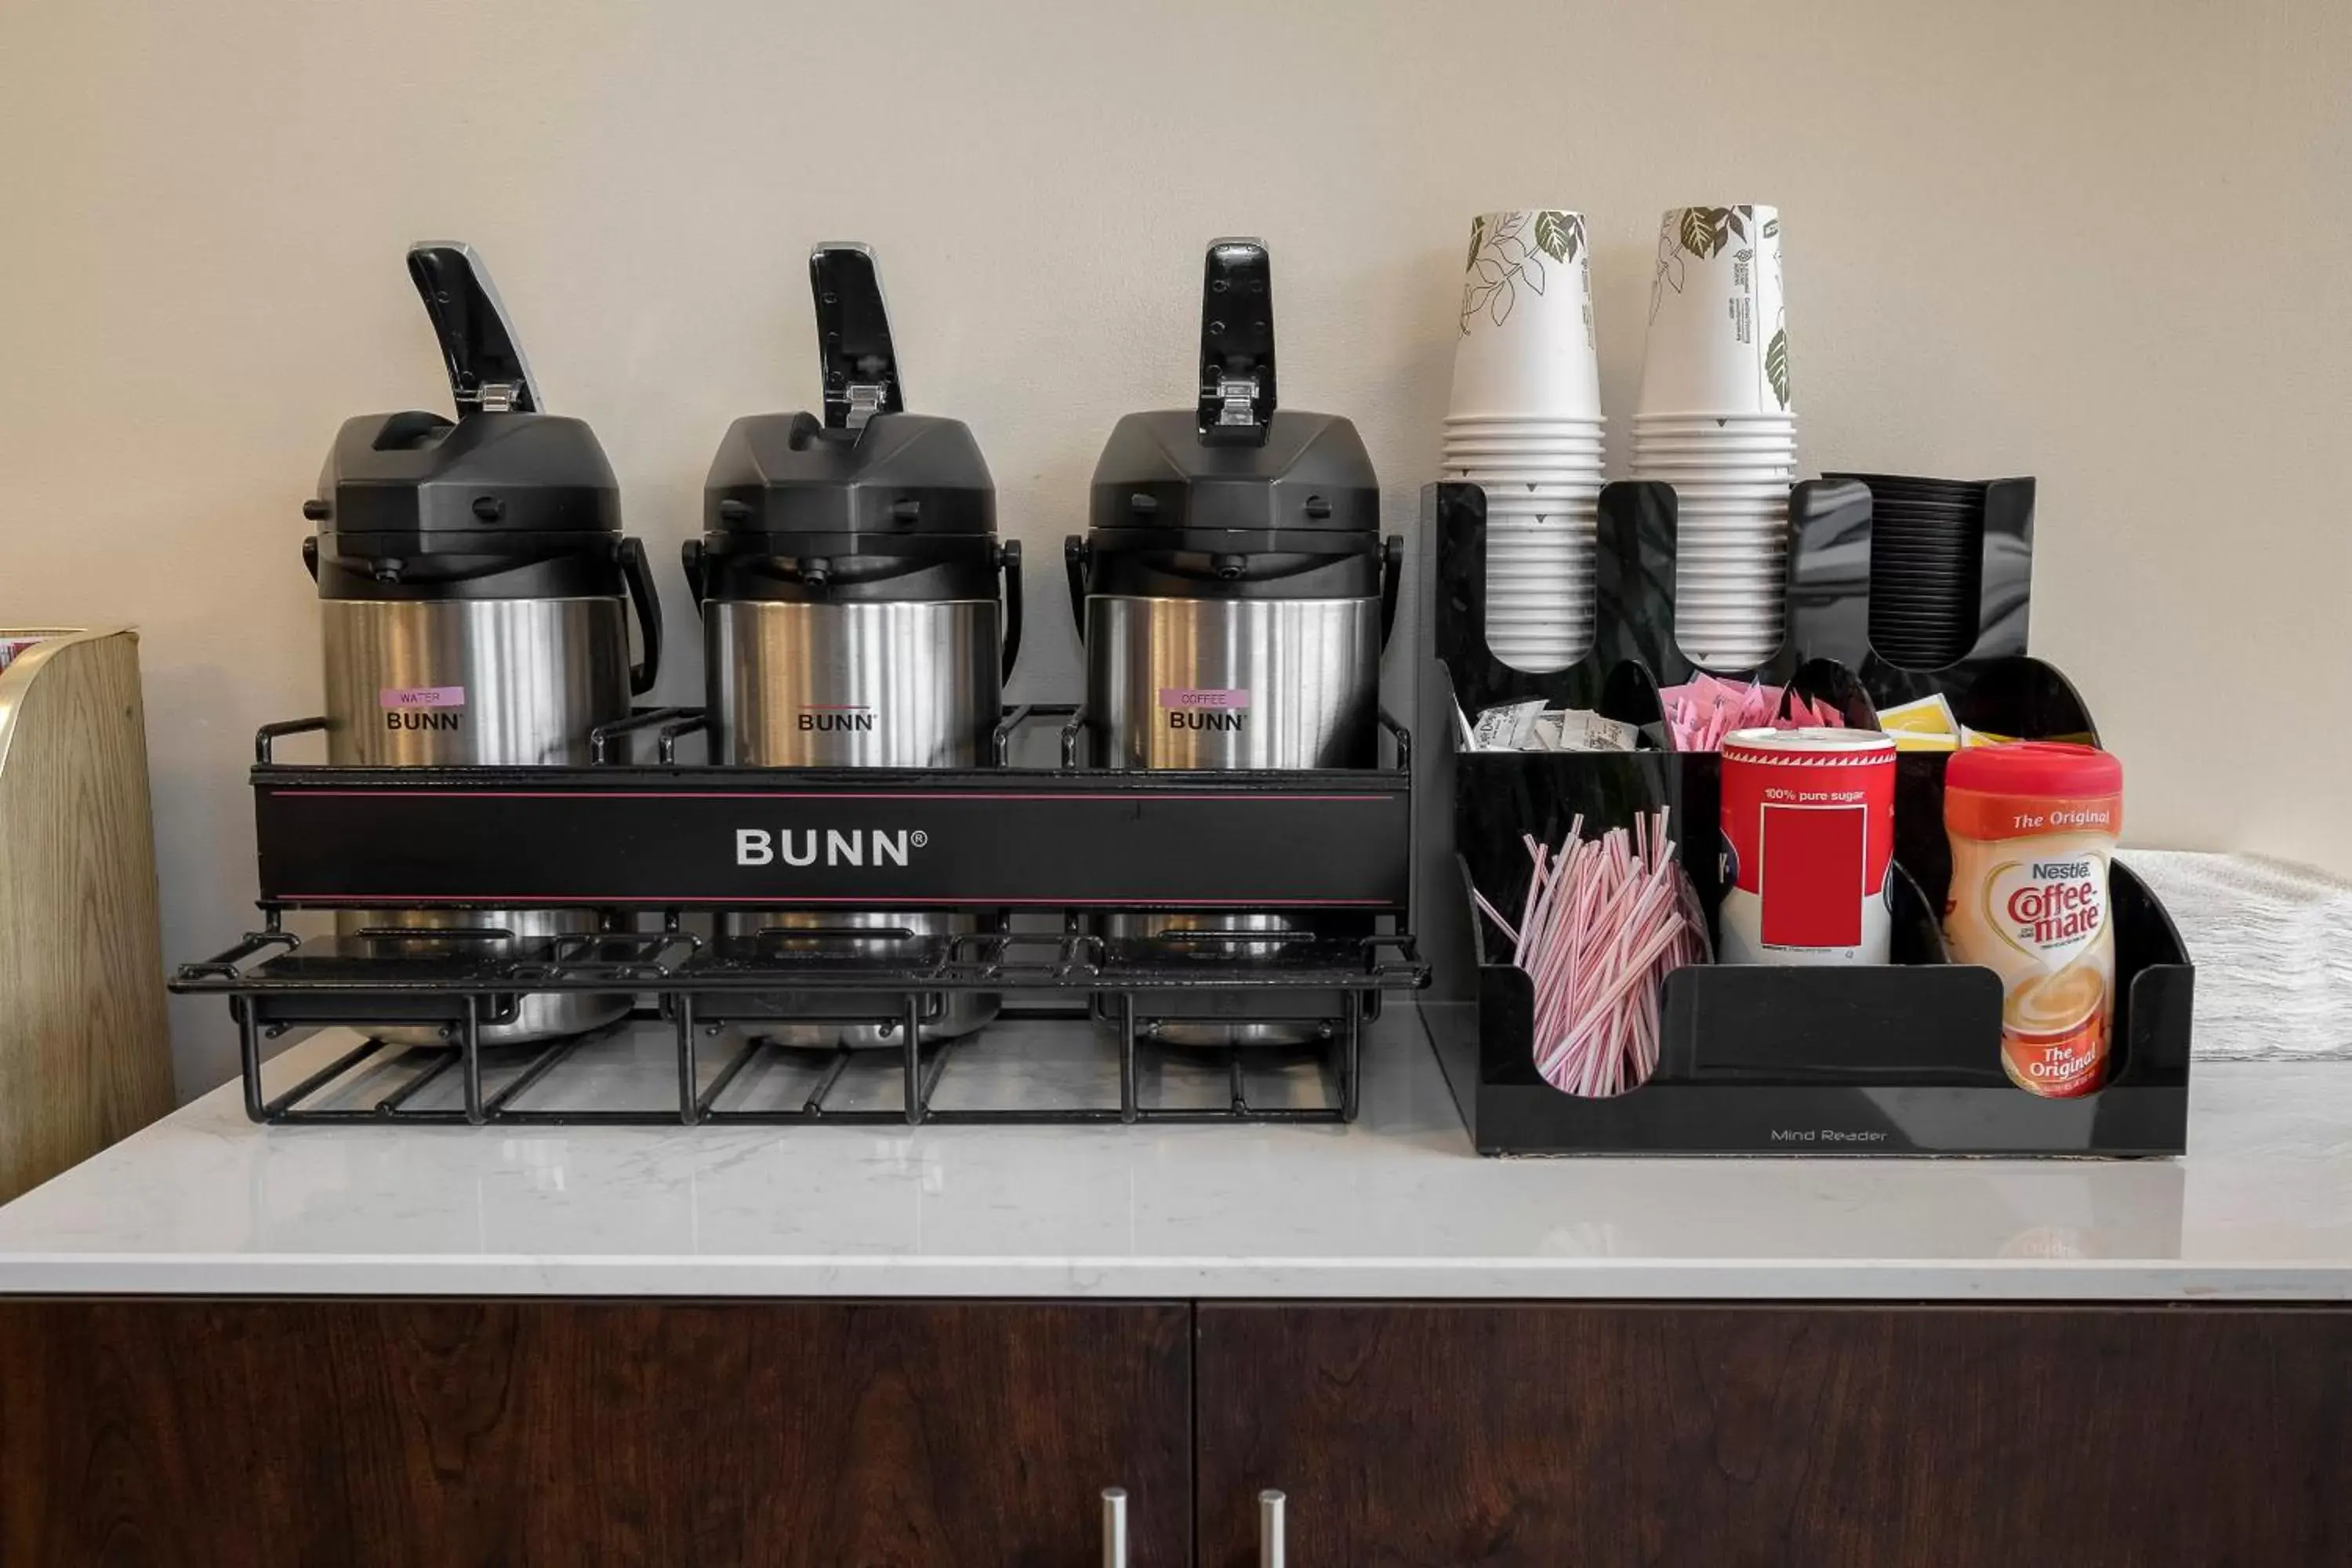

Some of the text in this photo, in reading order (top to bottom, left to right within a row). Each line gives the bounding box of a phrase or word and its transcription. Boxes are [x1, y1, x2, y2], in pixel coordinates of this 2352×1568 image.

[401, 692, 440, 703] WATER
[1181, 694, 1226, 704] COFFEE
[387, 712, 459, 730] BUNN
[798, 714, 872, 731] BUNN
[1170, 711, 1243, 731] BUNN
[1765, 788, 1865, 802] 100% pure sugar
[2013, 809, 2110, 829] The Original
[2034, 906, 2099, 942] mate
[2030, 1041, 2096, 1080] Original
[2045, 1047, 2072, 1062] The
[1771, 1129, 1888, 1142] Mind Reader
